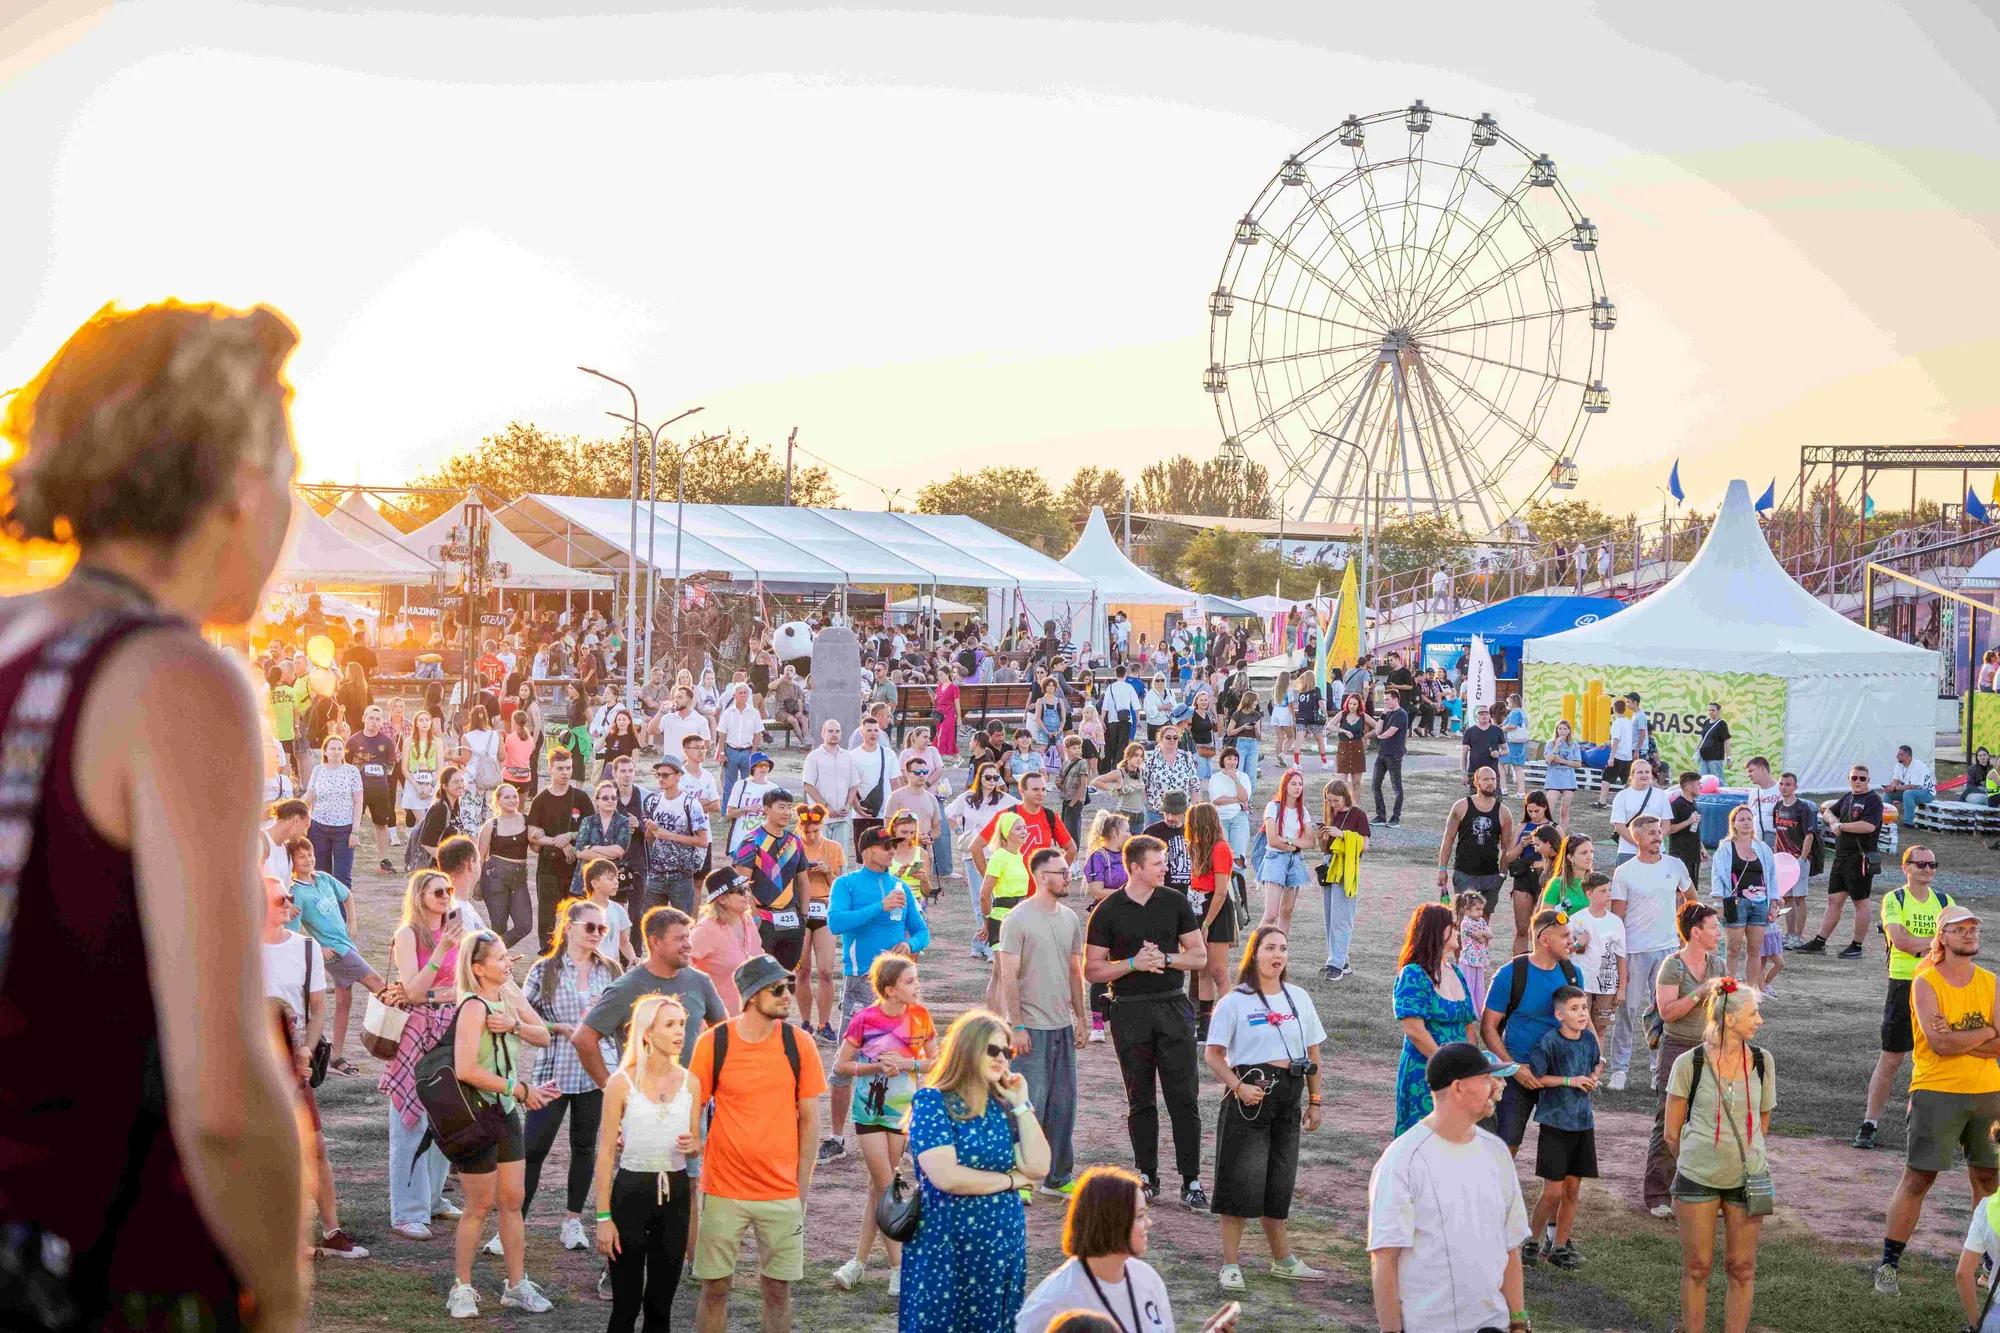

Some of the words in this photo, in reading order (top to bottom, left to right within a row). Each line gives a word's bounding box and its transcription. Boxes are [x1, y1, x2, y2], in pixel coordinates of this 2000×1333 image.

[1913, 913, 1934, 921] БЕГИ
[1913, 920, 1937, 928] ТЕМП
[1912, 927, 1935, 935] ЛЕТА
